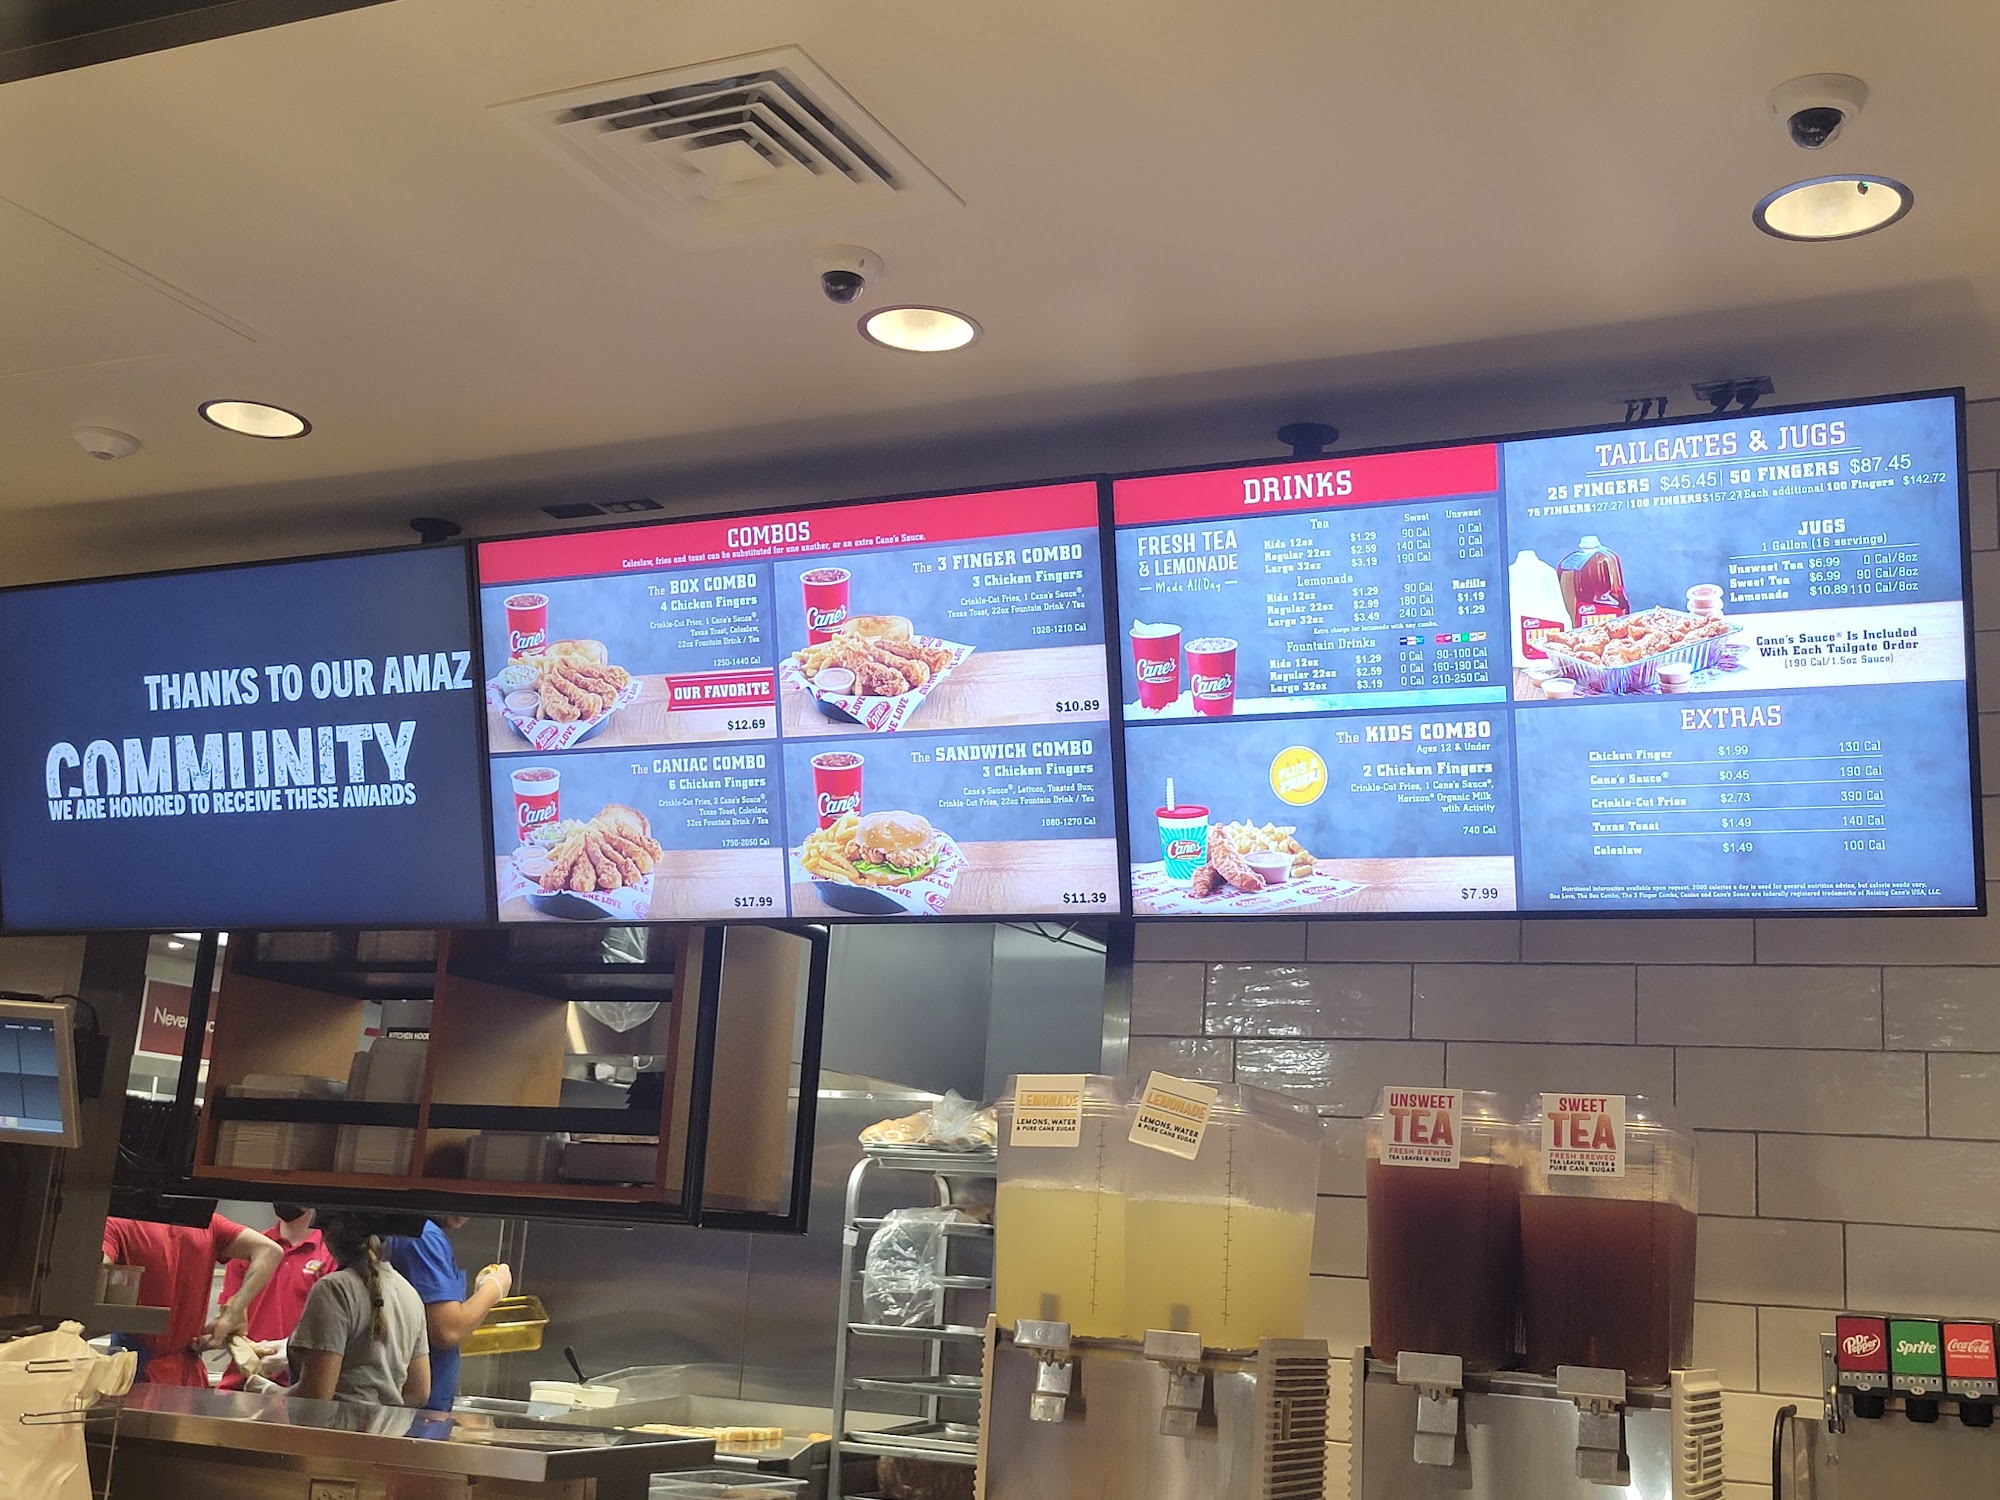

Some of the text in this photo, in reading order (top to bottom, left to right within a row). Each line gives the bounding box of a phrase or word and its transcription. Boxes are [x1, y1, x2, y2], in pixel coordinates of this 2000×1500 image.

[1595, 421, 1846, 467] TAILGATES & JUGS
[1729, 454, 1912, 485] 50 FINGERS $87.45
[1243, 470, 1352, 504] DRINKS
[1547, 472, 1716, 501] 25 FINGERS $45.45
[1310, 518, 1329, 529] Tea
[1797, 519, 1846, 536] JUGS
[727, 521, 810, 547] COMBOS
[1137, 529, 1238, 557] FRESH TEA
[1350, 531, 1376, 542] $1.29
[622, 558, 653, 568] Coleslaw,
[655, 556, 672, 564] fries
[673, 555, 686, 563] and
[688, 553, 705, 561] toast
[708, 552, 720, 560] can
[722, 550, 730, 558] be
[732, 546, 771, 558] substituted
[773, 546, 784, 554] for
[801, 542, 830, 552] another,
[843, 540, 852, 548] an
[854, 538, 873, 547] extra
[875, 534, 899, 545] Cane's
[1351, 544, 1377, 555] $2.59
[913, 544, 1082, 574] The 3 FINGER COMBO
[1139, 554, 1238, 578] & LEMONADE
[1351, 557, 1377, 568] $3.19
[648, 573, 756, 596] The BOX COMBO
[972, 569, 1083, 587] 3 Chicken Fingers
[1155, 577, 1221, 593] Made All Day
[1297, 572, 1354, 586] Lemonade
[661, 596, 757, 612] 4 Chicken Fingers
[807, 604, 847, 630] Cane's
[1032, 623, 1087, 635] 1020-1210 Cal
[1757, 635, 1794, 646] Cane's
[1847, 631, 1858, 641] Is
[1863, 628, 1917, 639] Included
[510, 628, 546, 652] Cane's
[1286, 637, 1376, 652] Fountain Drinks
[1760, 640, 1919, 657] With Each Tailgate Order
[1137, 657, 1177, 681] Cane's
[144, 651, 473, 712] THANKS TO OUR AMAZ
[1191, 673, 1232, 697] Cane's
[674, 682, 769, 700] OUR FAVORITE
[1056, 700, 1100, 712] $10.89
[727, 719, 765, 730] $12.69
[1681, 705, 1782, 730] EXTRAS
[1336, 721, 1491, 744] The KIDS COMBO
[46, 721, 417, 798] COMMUNITY
[911, 740, 1093, 763] The SANDWICH COMBO
[631, 755, 766, 775] The CANIAC COMBO
[982, 762, 1094, 778] 3 Chicken Fingers
[1363, 760, 1493, 777] 2 Chicken Fingers
[669, 777, 766, 790] 6 Chicken Fingers
[48, 783, 416, 821] WE ARE HONORED TO RECEIVE THESE AWARDS
[817, 791, 860, 817] Cane's
[517, 801, 558, 827] Cane's
[1084, 816, 1096, 825] Cal
[734, 897, 773, 907] $17.99
[1063, 892, 1106, 904] $11.39
[1461, 888, 1498, 900] $7.99
[1019, 1094, 1079, 1107] LEMONADE
[1149, 1092, 1207, 1119] LEMONADE
[1390, 1093, 1454, 1109] UNSWEET
[1559, 1097, 1607, 1113] SWEET
[1017, 1118, 1049, 1126] LEMONS,
[1140, 1115, 1199, 1138] LEMONS, WATER
[1389, 1109, 1454, 1145] TEA
[1547, 1113, 1616, 1149] TEA
[1143, 1124, 1158, 1134] PURE
[1160, 1130, 1175, 1139] CANE
[1176, 1135, 1196, 1144] SUGAR
[1389, 1147, 1415, 1155] FRESH
[1847, 1337, 1878, 1354] Pepper
[1856, 1334, 1869, 1345] Dr
[1896, 1340, 1936, 1355] Sprite
